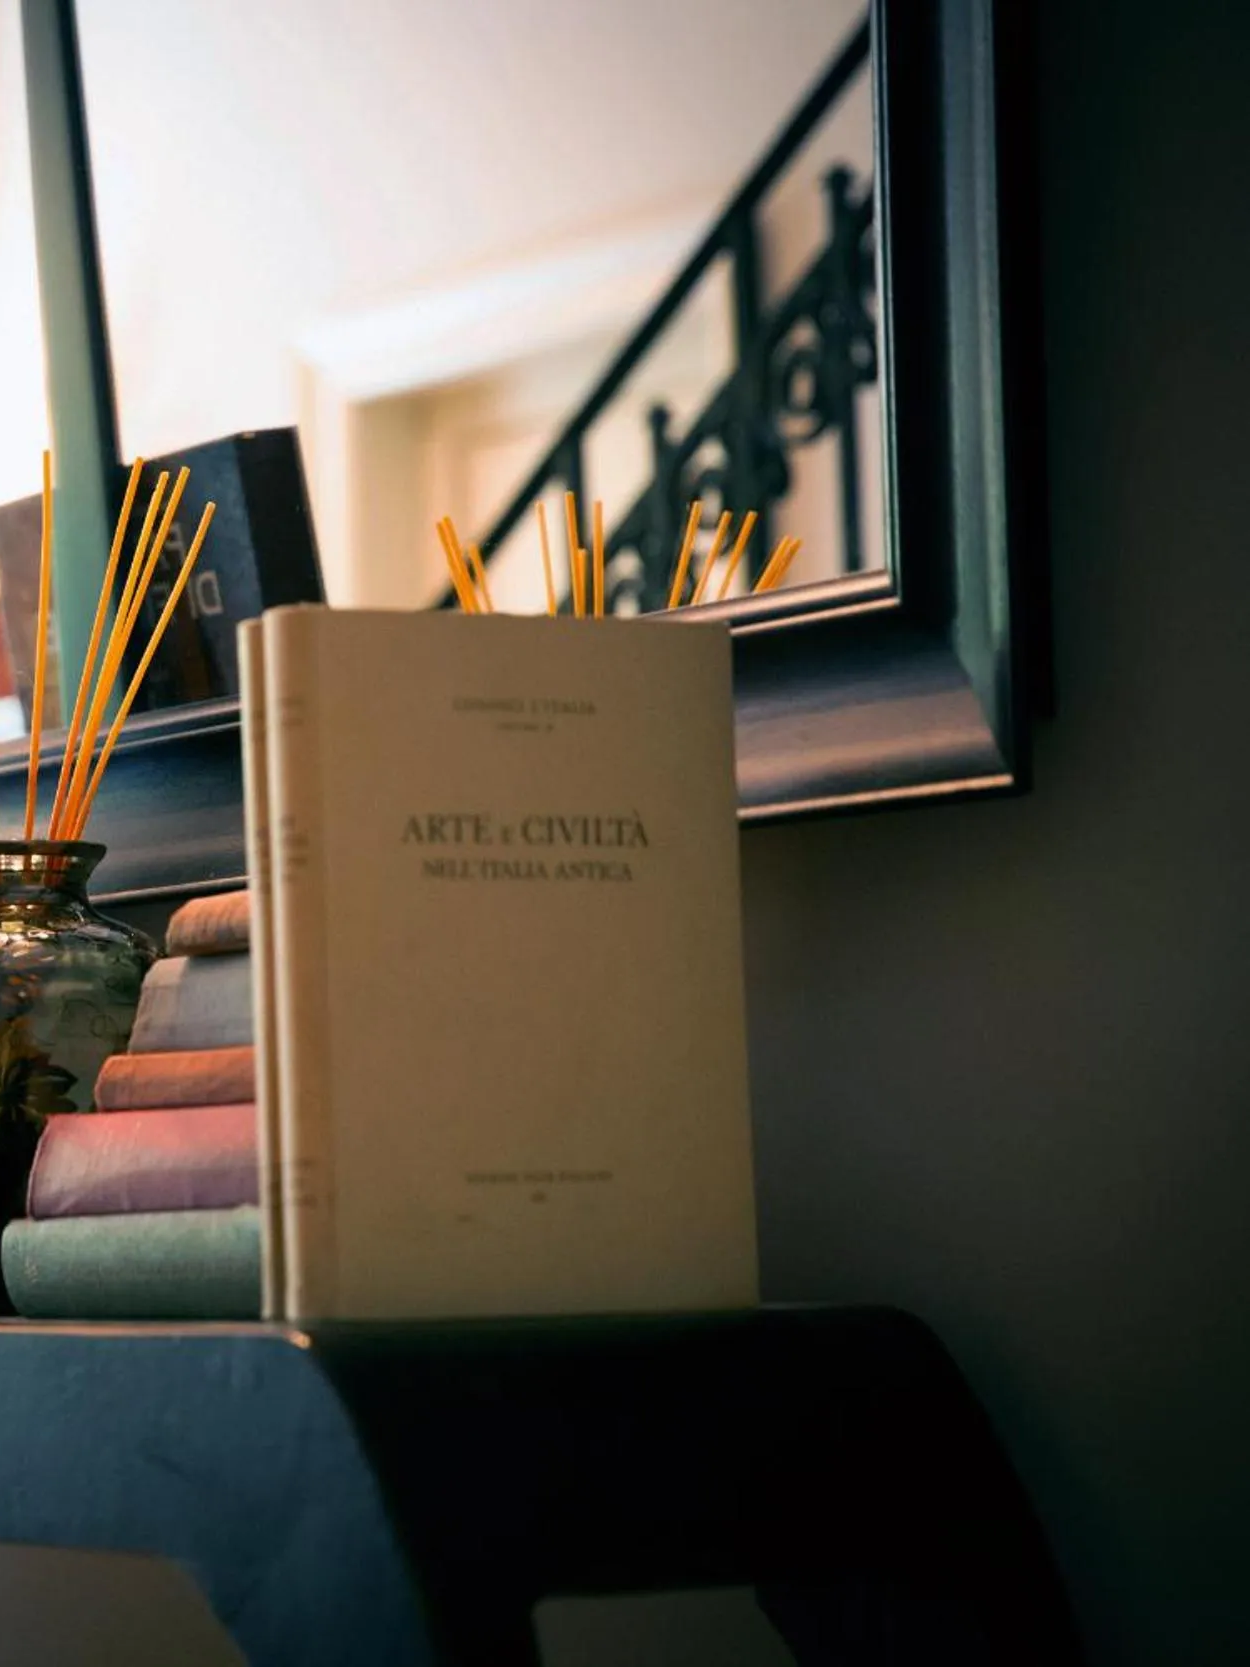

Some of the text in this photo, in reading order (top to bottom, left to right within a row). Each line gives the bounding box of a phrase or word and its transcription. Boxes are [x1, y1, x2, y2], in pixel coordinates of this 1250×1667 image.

[401, 813, 493, 845] ARTE
[519, 808, 649, 848] CIVILTÀ
[554, 860, 633, 882] ANTICA
